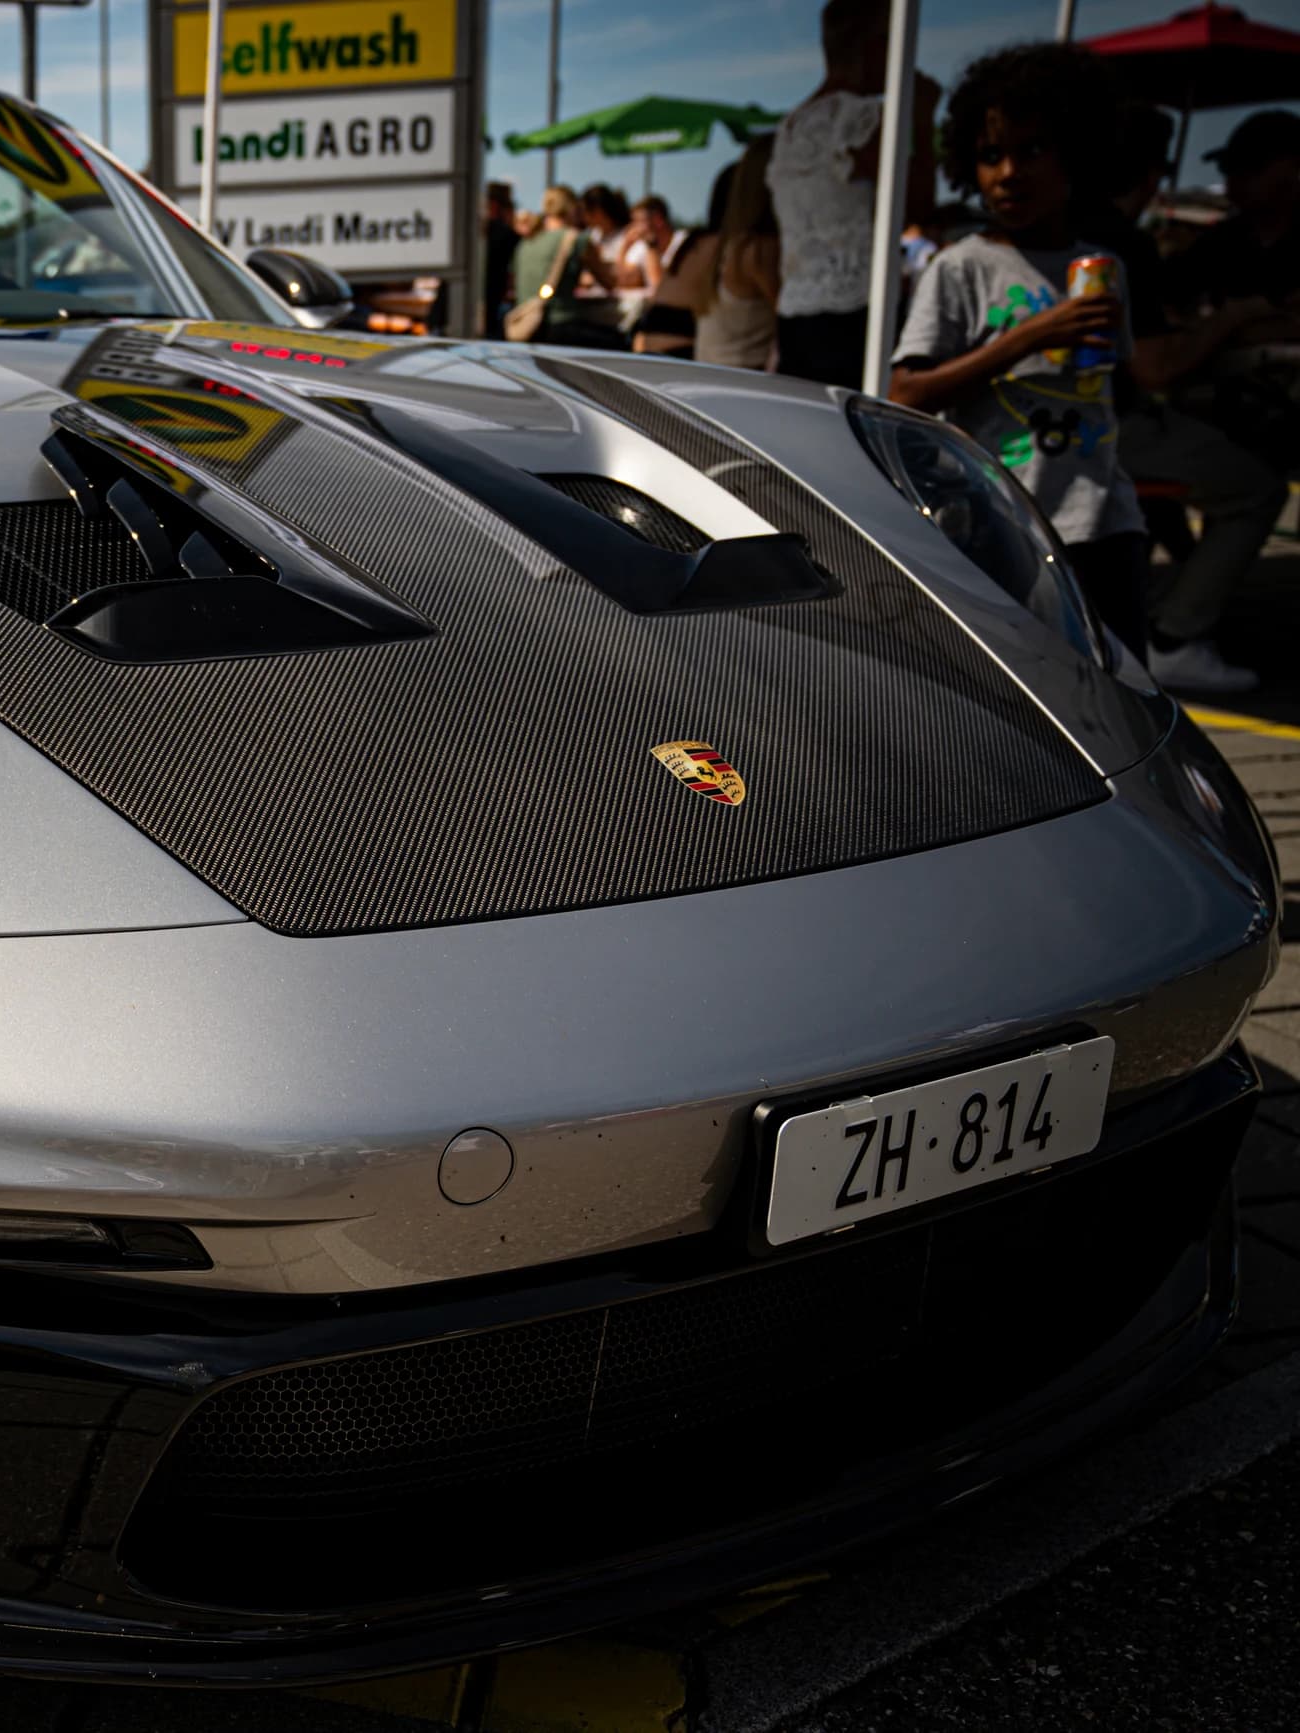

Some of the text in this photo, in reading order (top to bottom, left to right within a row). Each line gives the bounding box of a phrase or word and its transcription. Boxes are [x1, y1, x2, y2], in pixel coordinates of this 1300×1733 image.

[316, 114, 434, 158] AGRO
[245, 213, 323, 246] Landi
[334, 209, 431, 244] March
